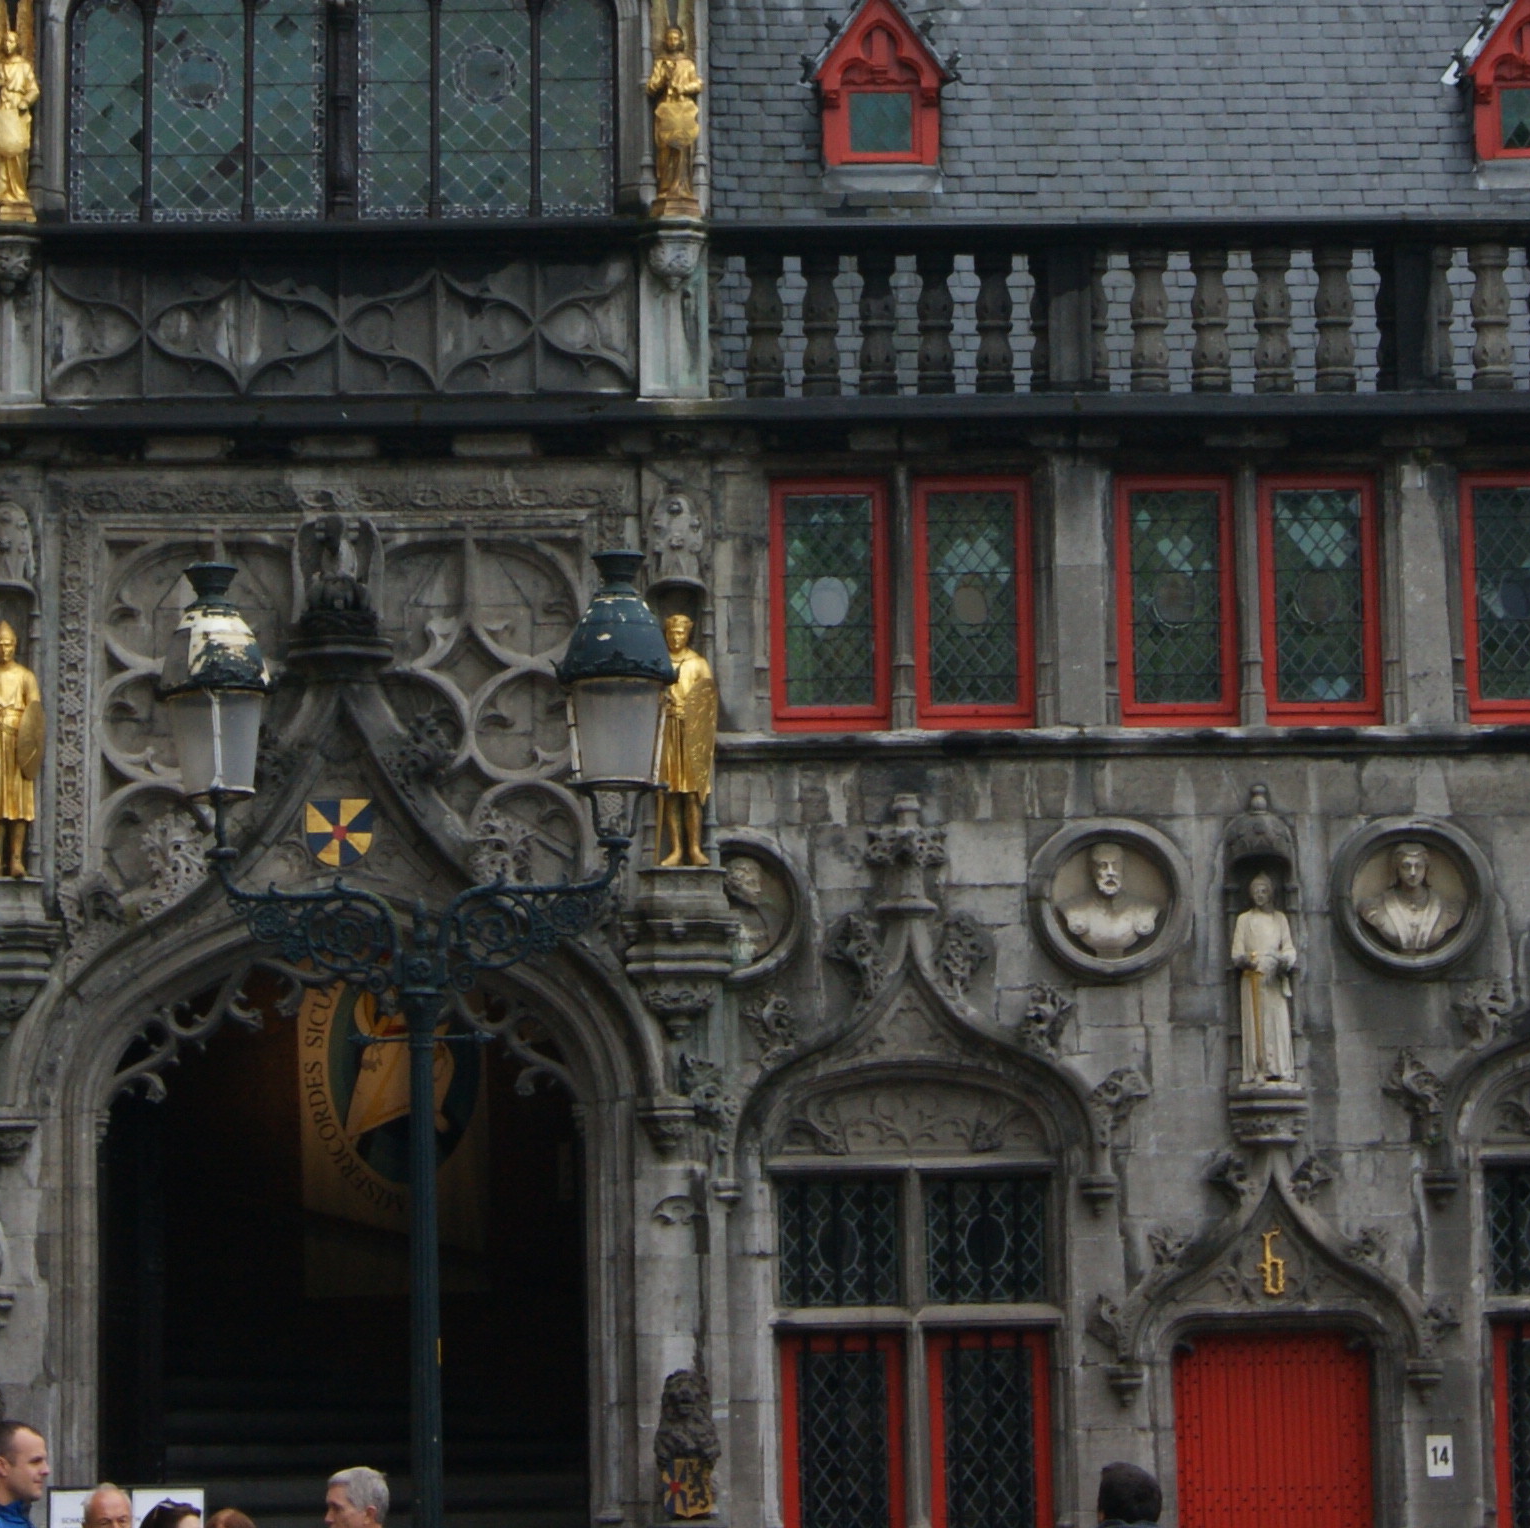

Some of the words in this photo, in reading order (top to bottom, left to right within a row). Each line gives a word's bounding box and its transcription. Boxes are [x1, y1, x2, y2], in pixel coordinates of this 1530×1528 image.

[304, 979, 337, 1049] SICU
[304, 1060, 406, 1213] MISERICORDES
[1431, 1445, 1450, 1466] 14
